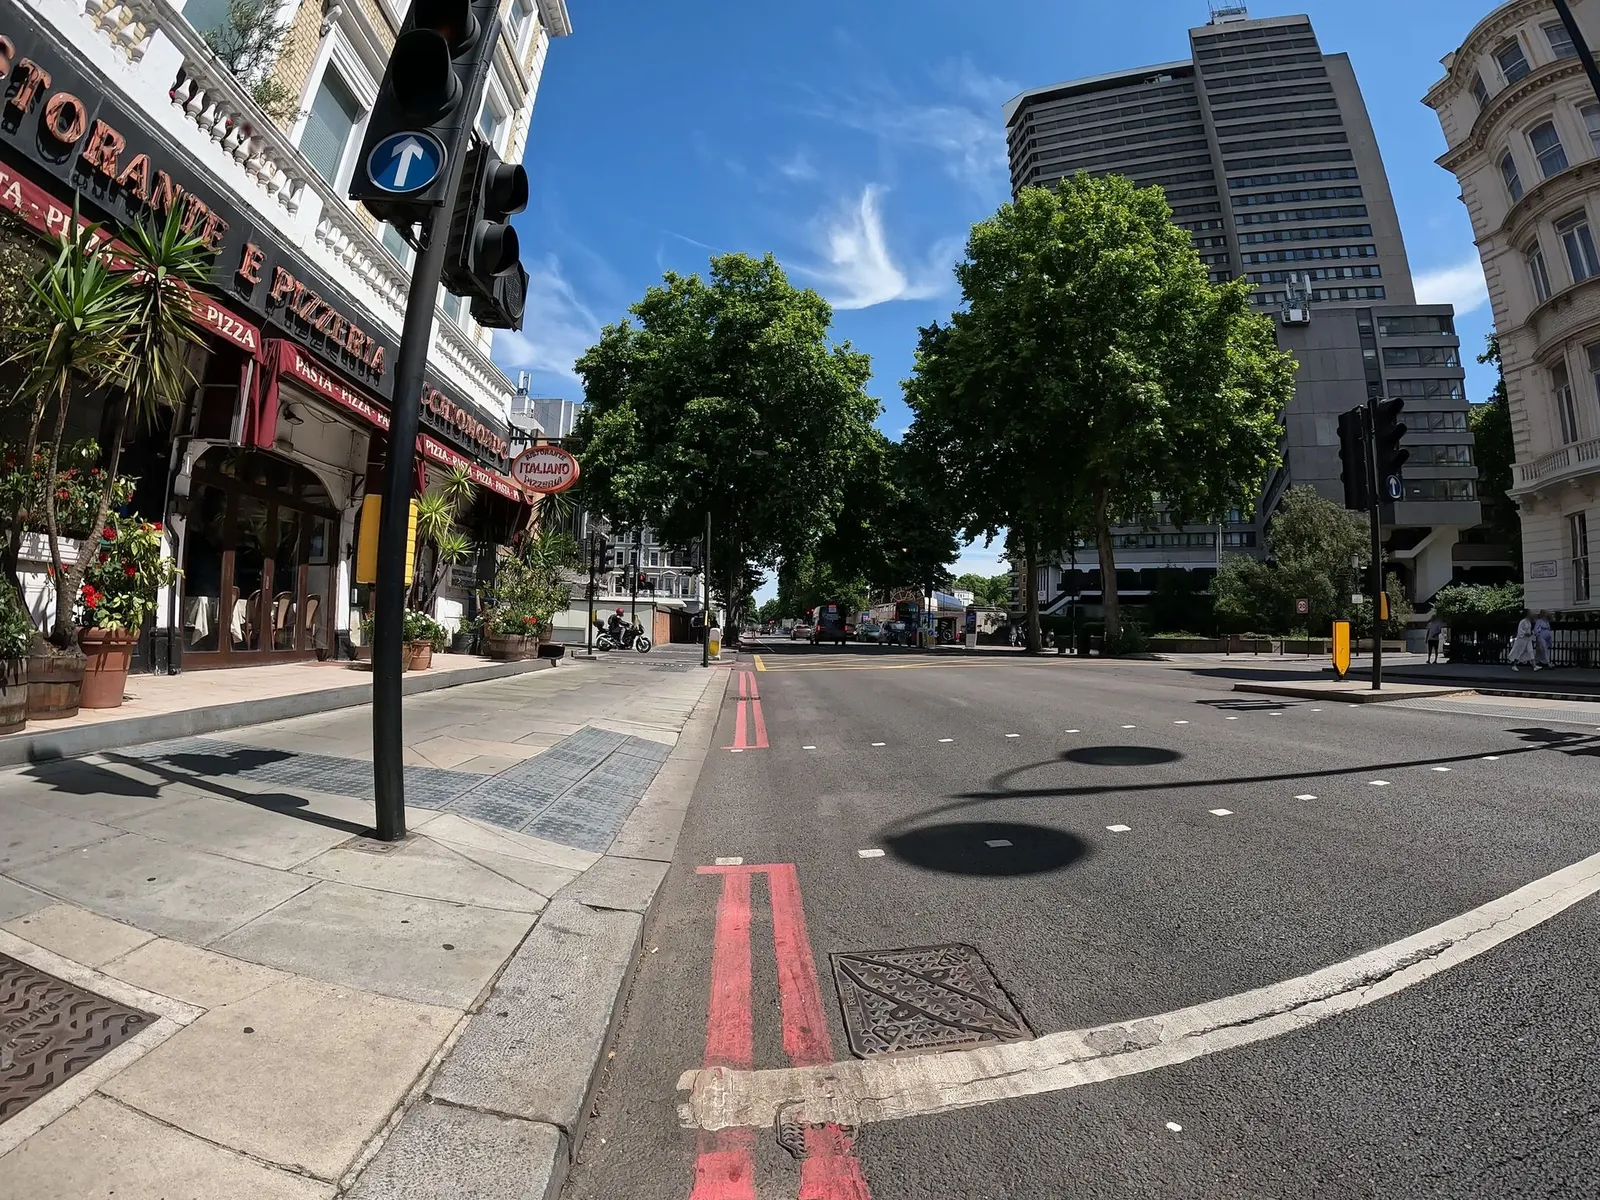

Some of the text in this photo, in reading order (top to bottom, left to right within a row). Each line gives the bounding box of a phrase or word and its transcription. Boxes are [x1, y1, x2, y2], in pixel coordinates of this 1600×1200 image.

[207, 305, 256, 348] PIZZA
[239, 241, 267, 285] E
[271, 265, 387, 375] PIZZERIA
[295, 355, 333, 392] PASTA
[341, 385, 371, 416] PIZZA
[425, 440, 449, 462] PIZZA
[476, 471, 492, 486] PIZZA
[495, 481, 510, 496] PASTA
[520, 462, 570, 475] ITALIANO
[525, 450, 566, 461] RISTORANTE
[524, 475, 563, 488] PIZZERIA
